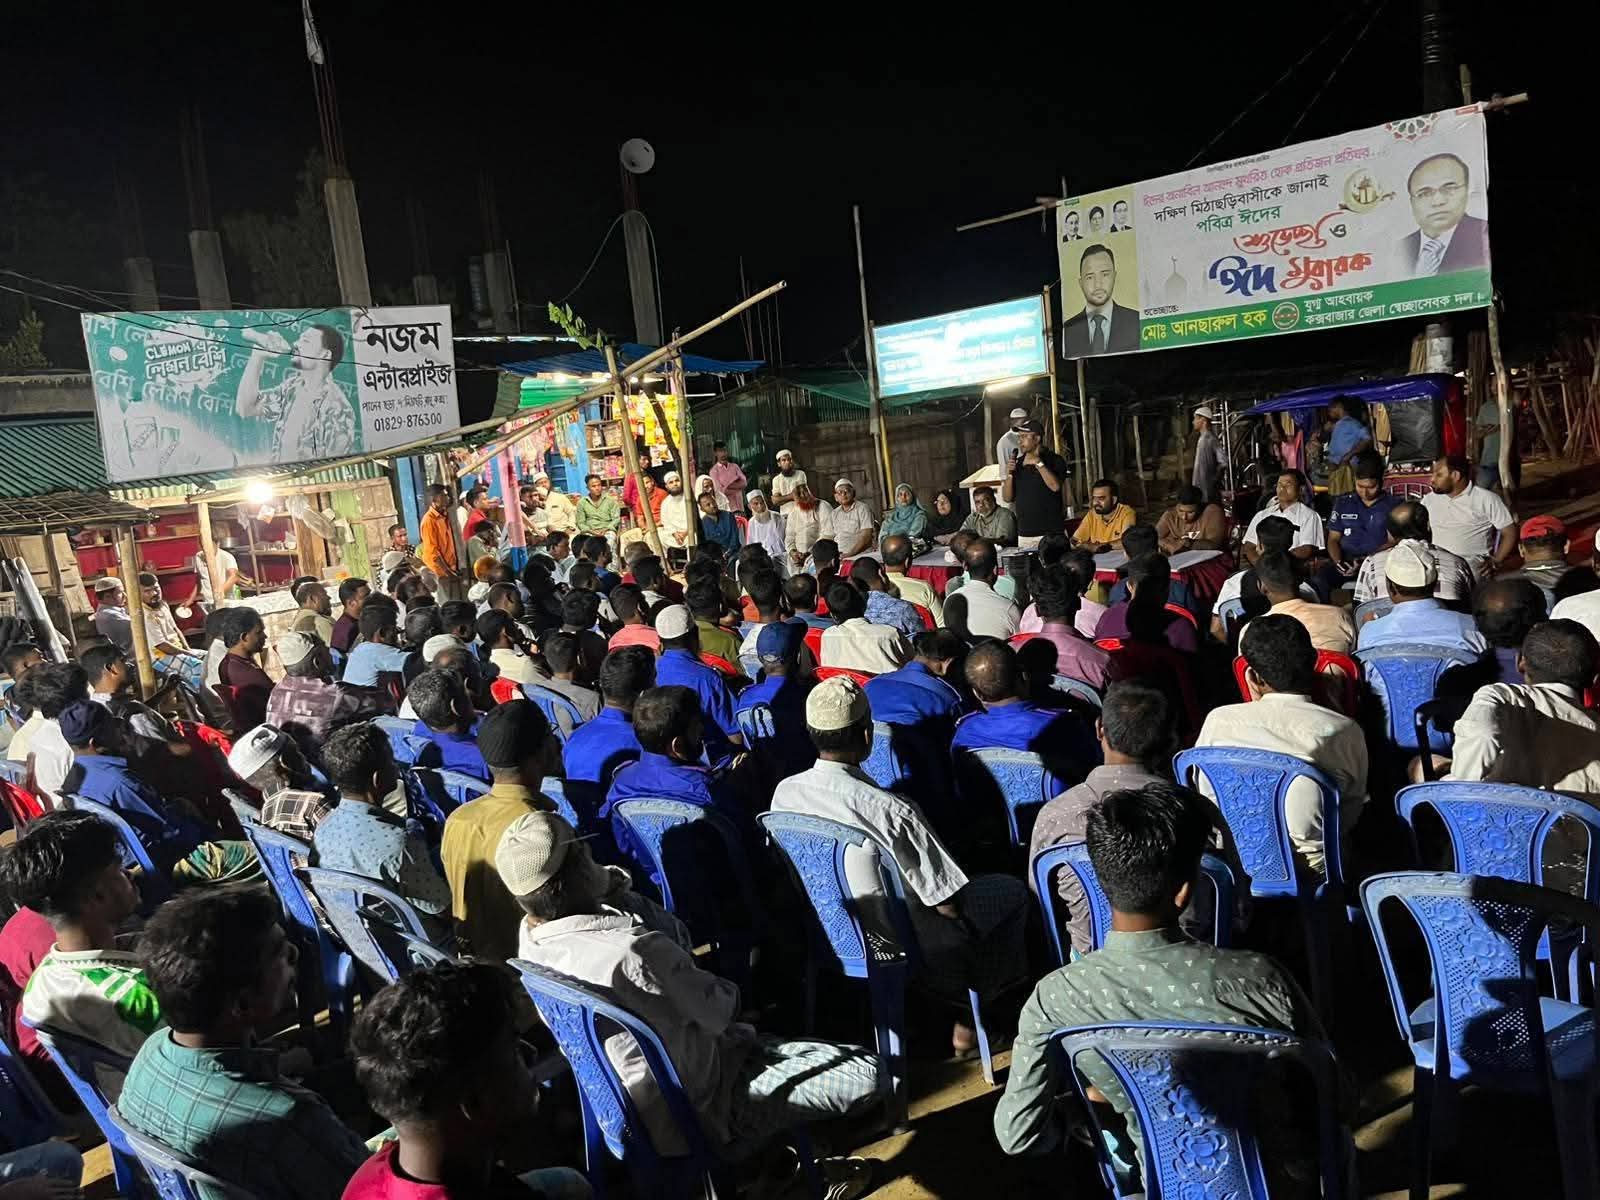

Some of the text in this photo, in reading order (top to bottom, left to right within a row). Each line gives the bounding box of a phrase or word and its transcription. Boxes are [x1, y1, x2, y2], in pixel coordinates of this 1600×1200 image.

[1154, 173, 1330, 222] দক্ষিণ মিঠাছড়িবাসীকে জানাই
[1196, 205, 1282, 232] পবিত্র ঈদের
[1233, 211, 1347, 256] শুভেচ্ছা ও
[1208, 252, 1375, 297] ঈদ মুবারক
[1141, 322, 1167, 341] মোঃ
[1170, 312, 1239, 337] আনছারুল
[1241, 308, 1269, 329] হক
[1303, 308, 1355, 325] কক্সবাজার
[1359, 304, 1386, 318] জেলা
[1389, 295, 1452, 314] স্বেচ্ছাসেবক
[1454, 292, 1474, 305] দল
[361, 322, 453, 392] নজম এন্টারপ্রাইজ
